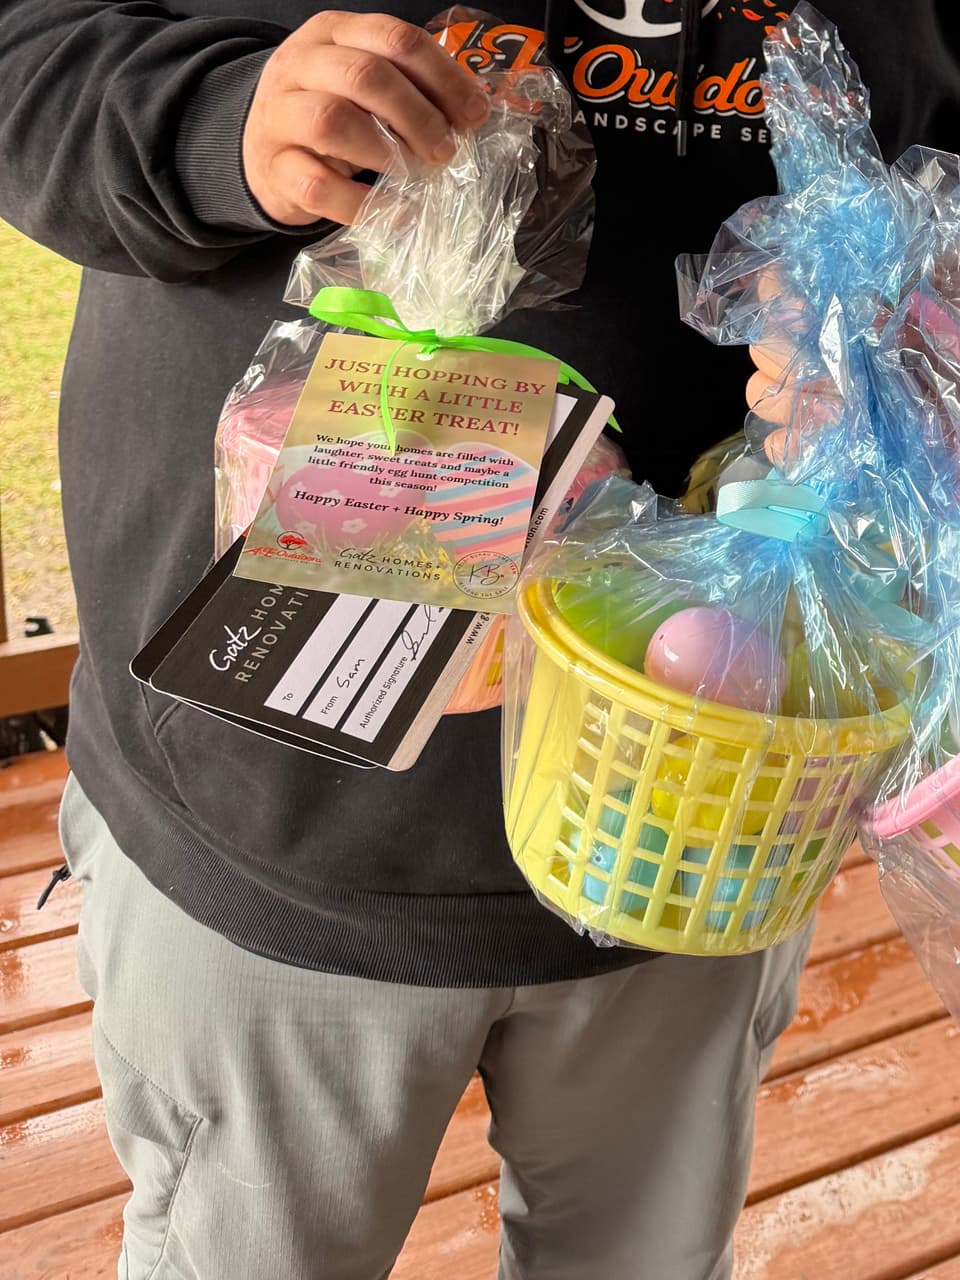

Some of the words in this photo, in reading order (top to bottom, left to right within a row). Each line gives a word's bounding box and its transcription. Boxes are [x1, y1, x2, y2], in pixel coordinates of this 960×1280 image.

[572, 43, 767, 118] Oudo
[573, 112, 723, 140] ANDSCPE
[324, 358, 388, 374] JUST
[393, 365, 507, 390] HOPPING
[514, 380, 547, 395] BY
[338, 379, 408, 402] WITH
[413, 389, 431, 402] A
[438, 391, 524, 414] LITTLE
[432, 411, 521, 436] TREAT!
[313, 445, 365, 460] laughter,
[367, 453, 401, 464] sweet
[404, 458, 438, 469] treats
[440, 463, 462, 472] and
[463, 466, 501, 477] maybe
[316, 434, 334, 444] We
[335, 437, 365, 448] hope
[396, 444, 433, 457] homes
[435, 451, 455, 459] are
[456, 452, 487, 463] filled
[488, 457, 515, 467] with
[307, 456, 337, 467] little
[338, 461, 385, 475] friendly
[387, 469, 408, 478] egg
[410, 470, 438, 480] hunt
[440, 474, 509, 489] competition
[368, 477, 392, 487] this
[394, 481, 438, 492] season!
[293, 490, 342, 508] Happy
[344, 498, 390, 512] Easter
[404, 506, 450, 521] Happy
[452, 511, 505, 527] Spring!
[334, 560, 441, 580] RENOVATIONS
[235, 591, 309, 682] RENOVATI
[465, 612, 491, 644] www.g
[209, 625, 262, 671] Gatz
[336, 658, 366, 689] Sam
[282, 692, 294, 702] To
[320, 695, 338, 715] From
[359, 689, 387, 729] Authorized
[384, 656, 409, 690] Signature
